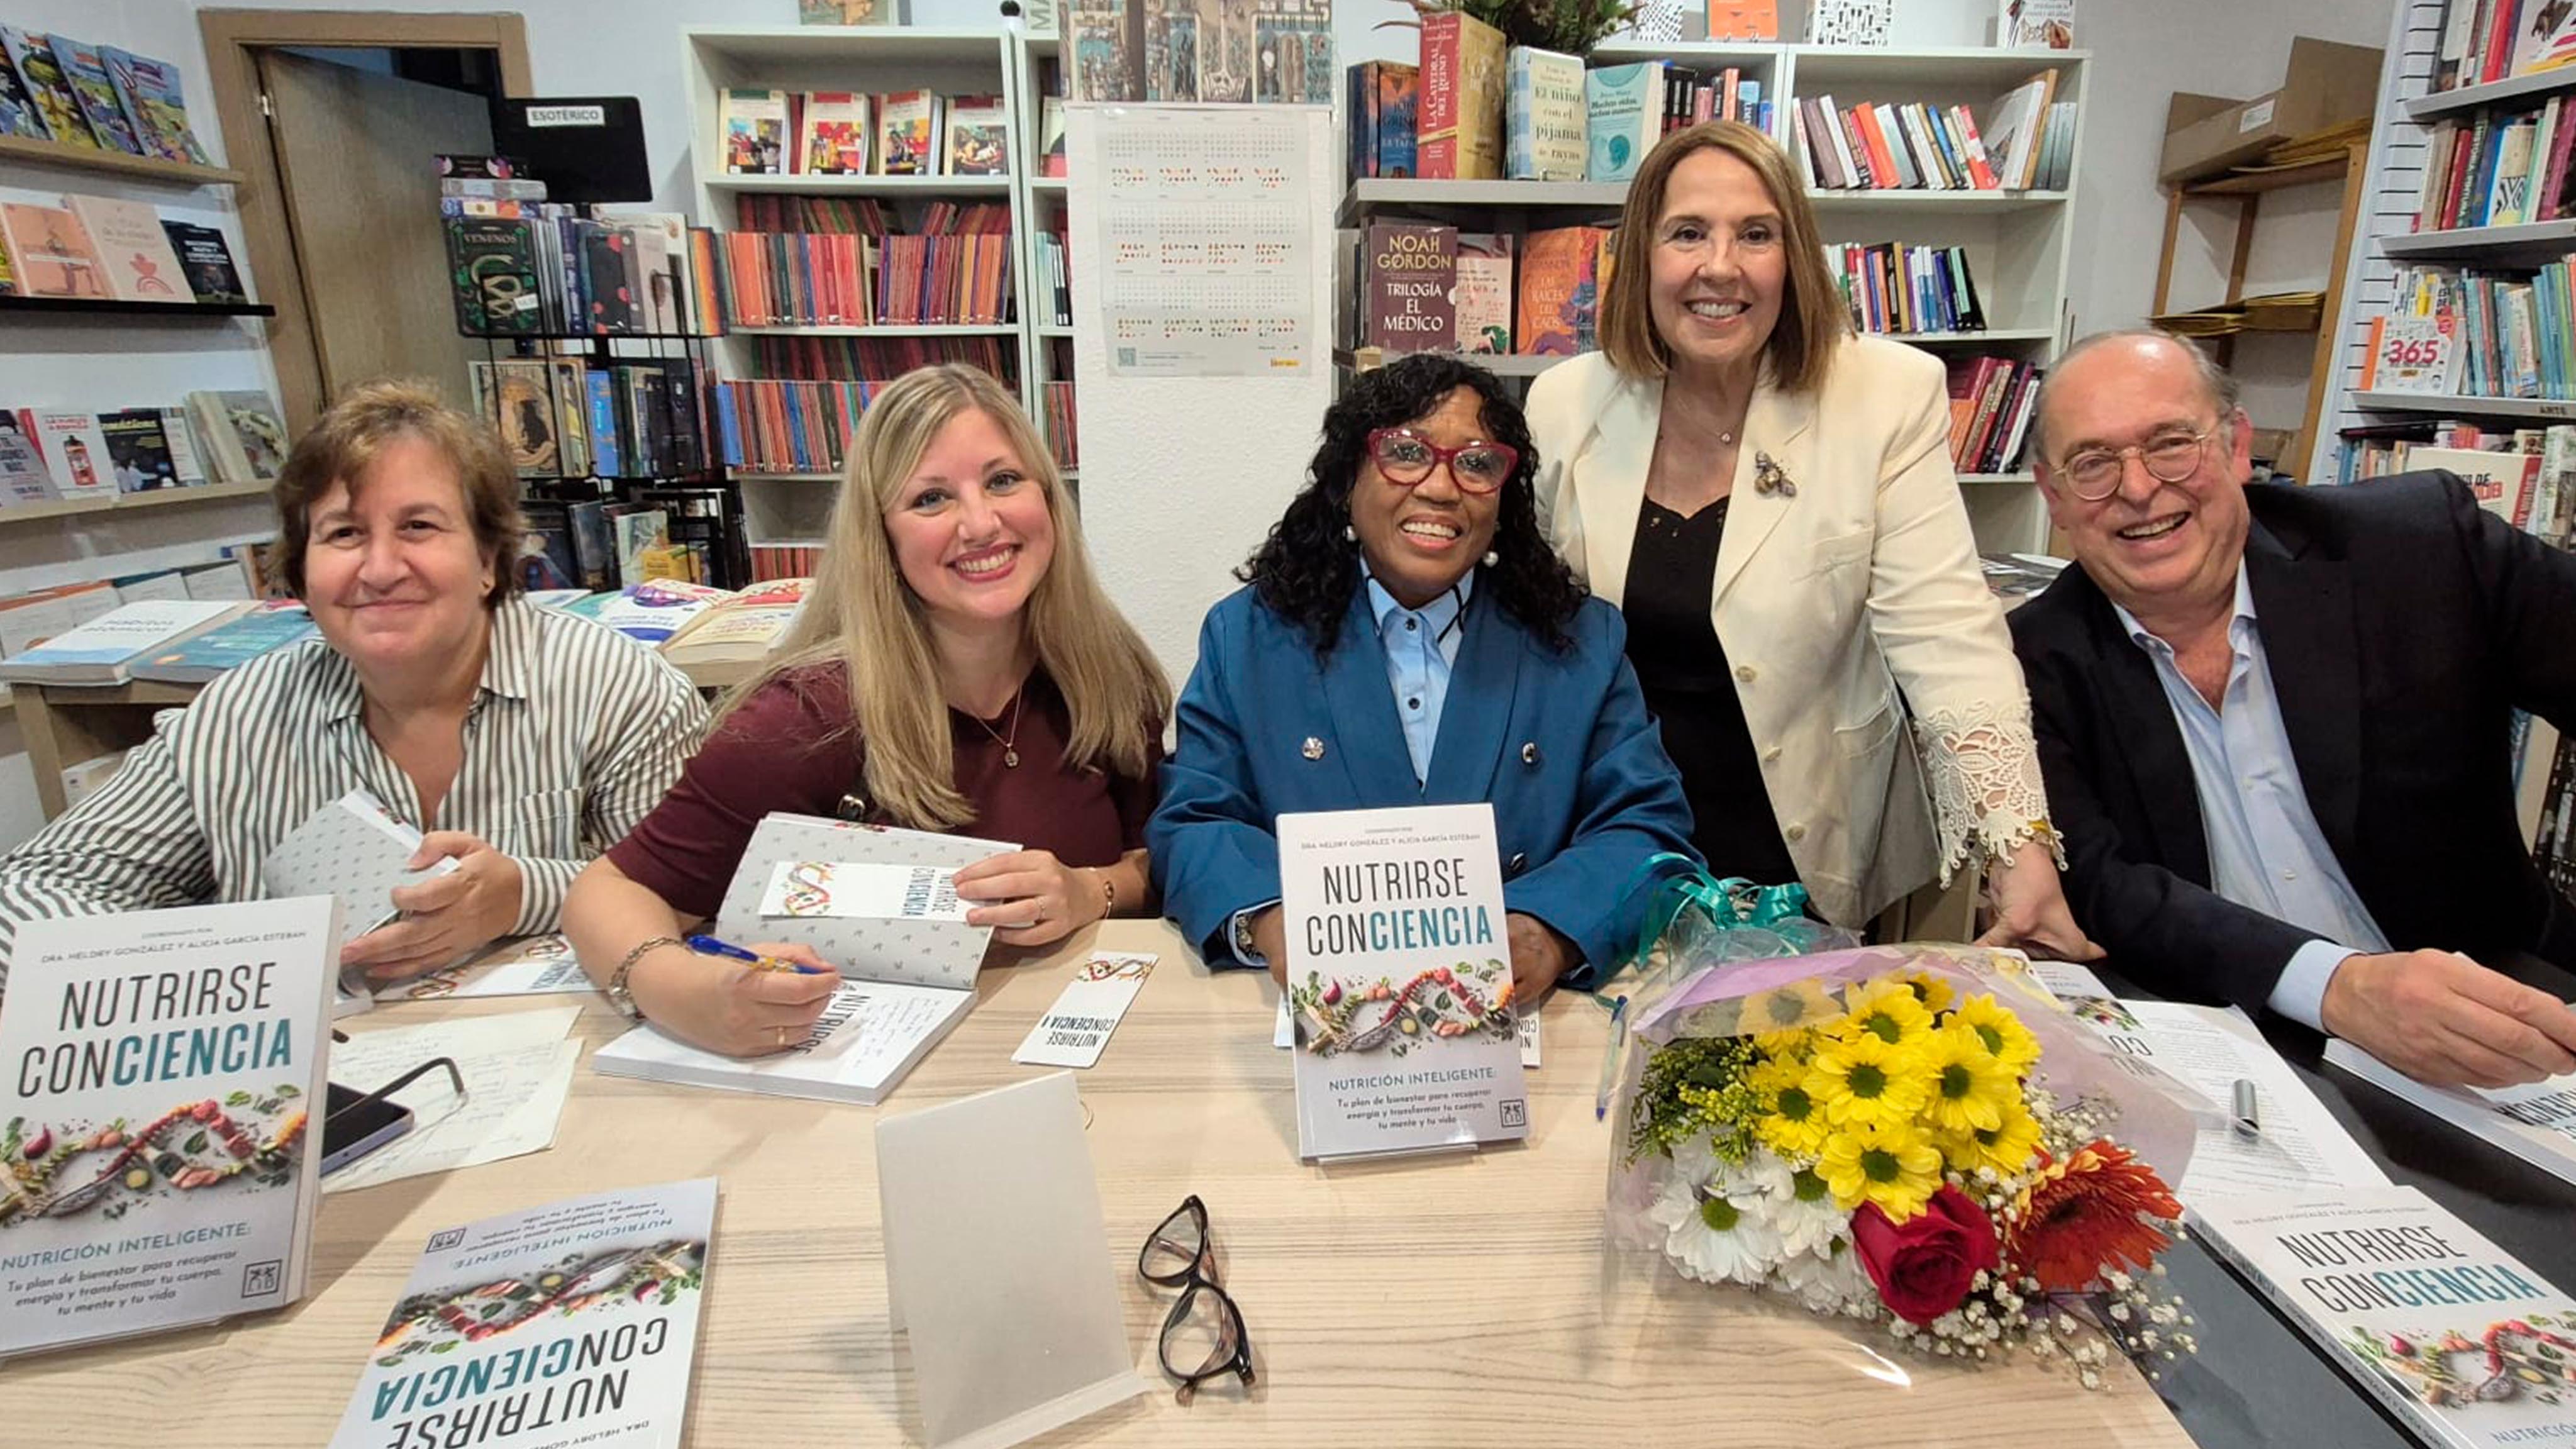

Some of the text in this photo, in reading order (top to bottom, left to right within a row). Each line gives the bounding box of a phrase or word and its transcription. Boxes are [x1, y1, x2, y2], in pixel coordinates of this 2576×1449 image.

[1389, 235, 1440, 252] NOAH
[1377, 254, 1452, 269] GORDON
[1386, 280, 1442, 297] TRILOGÍA
[1406, 299, 1422, 314] EL
[1383, 314, 1444, 331] MÉDICO
[2388, 340, 2438, 364] 365
[901, 868, 935, 916] CONCIENCIA
[1324, 858, 1468, 904] NUTRIRSE
[1307, 905, 1493, 955] CONCIENCIA
[59, 962, 277, 1031] NUTRIRSE
[1050, 1016, 1114, 1031] CONCIENCIA
[1046, 1031, 1099, 1048] NUTRIRSE
[18, 1018, 291, 1097] CONCIENCIA
[1329, 1075, 1404, 1092] NUTRICIÓN
[1, 1243, 111, 1271] NUTRICIÓN
[2275, 1225, 2467, 1269] NUTRIRSE
[8, 1251, 238, 1292] Tu plan de bienestar para recuperar
[67, 1292, 75, 1301] y
[79, 1274, 156, 1297] transformar
[160, 1275, 174, 1284] tu
[2300, 1264, 2547, 1313] CONCIENCIA
[58, 1288, 176, 1316] tu mente y tu vida
[372, 1318, 668, 1421] CONCIENCIA
[386, 1369, 629, 1449] NUTRIRSE
